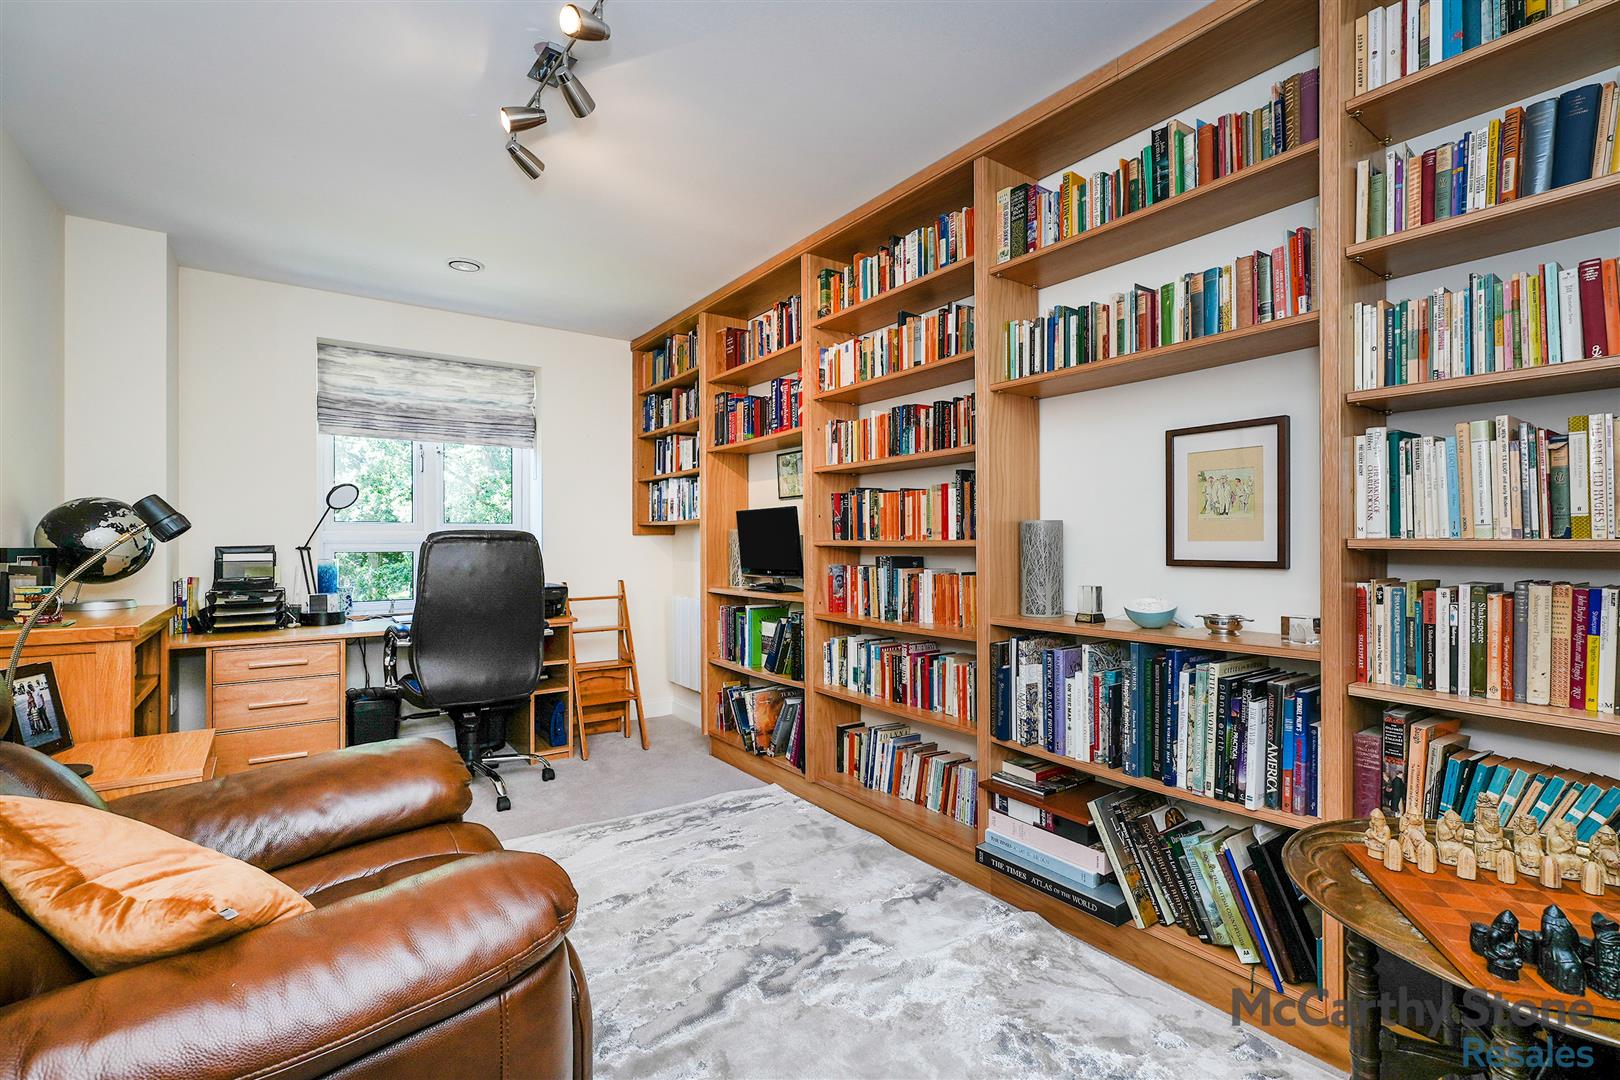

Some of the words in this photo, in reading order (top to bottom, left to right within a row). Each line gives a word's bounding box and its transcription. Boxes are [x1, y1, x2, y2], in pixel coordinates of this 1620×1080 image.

[1285, 81, 1294, 113] JOHN
[1154, 129, 1162, 162] Betjeman
[1373, 505, 1380, 514] OF
[1576, 594, 1587, 607] John
[1477, 602, 1486, 644] Shakespeare
[1573, 623, 1587, 652] Shakespeare
[1575, 651, 1584, 662] and
[1208, 666, 1216, 696] CITIES
[1572, 661, 1585, 681] Tragedy
[1067, 683, 1072, 694] ON
[1218, 684, 1227, 718] planet
[1047, 709, 1053, 718] OF
[1217, 722, 1225, 751] earth
[1266, 740, 1279, 794] AMERICA
[1118, 820, 1130, 839] Ireland
[1128, 845, 1140, 864] Britain
[1137, 866, 1151, 888] History
[1142, 822, 1155, 844] BOOK
[1150, 844, 1160, 855] OF
[1155, 856, 1174, 888] BRITISH
[1167, 888, 1186, 915] BIRDS
[991, 858, 1005, 870] THE
[1006, 864, 1028, 880] TIMES
[1031, 876, 1053, 892] ATLAS
[1053, 886, 1060, 895] OF
[1061, 890, 1072, 900] THE
[1072, 894, 1097, 912] WORLD
[1177, 879, 1191, 901] BIRDS
[1186, 872, 1199, 895] BIRDS
[1222, 902, 1246, 948] COUNTRYSIDE
